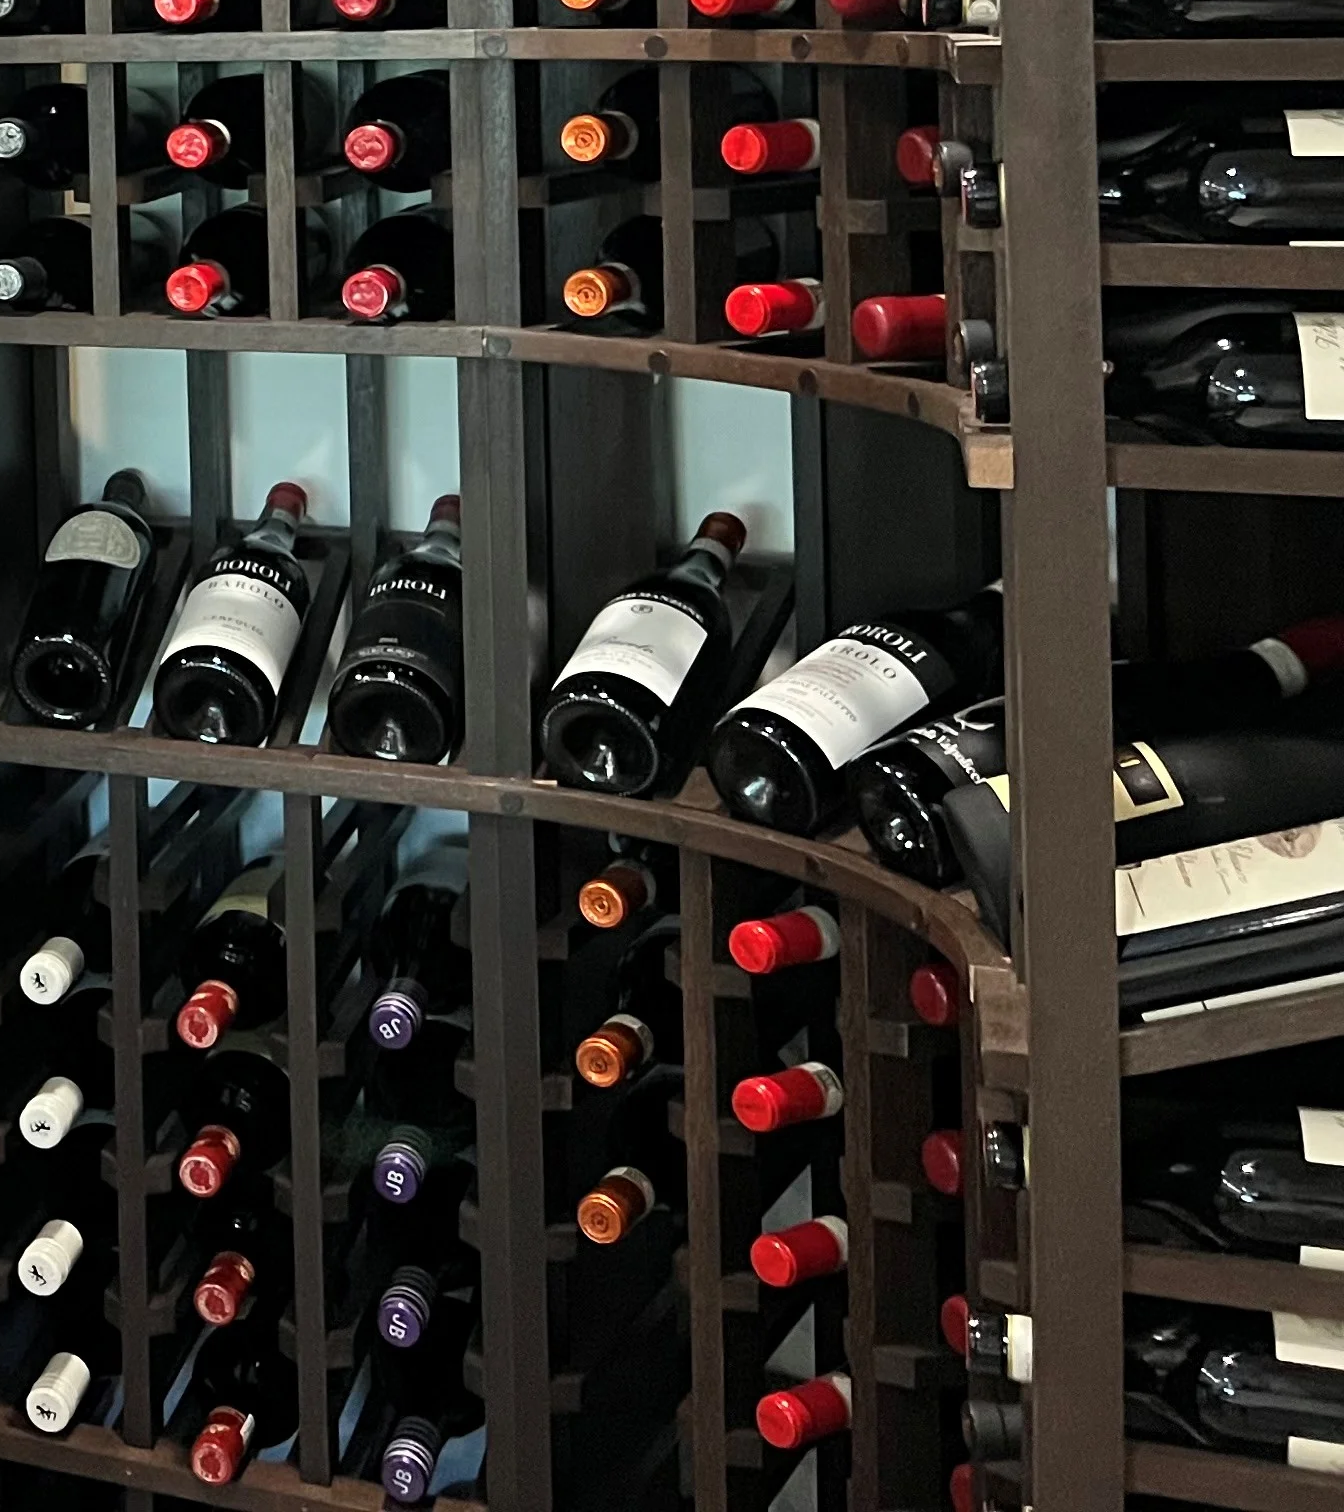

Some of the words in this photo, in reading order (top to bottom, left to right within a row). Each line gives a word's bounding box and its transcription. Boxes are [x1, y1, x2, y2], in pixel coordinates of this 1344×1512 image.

[215, 559, 292, 593] BOROLI
[369, 578, 447, 600] BOROLI
[208, 579, 285, 610] BAROLO
[378, 1017, 401, 1040] JB
[385, 1170, 405, 1196] JB
[388, 1313, 408, 1340] JB
[391, 1468, 413, 1495] JB
